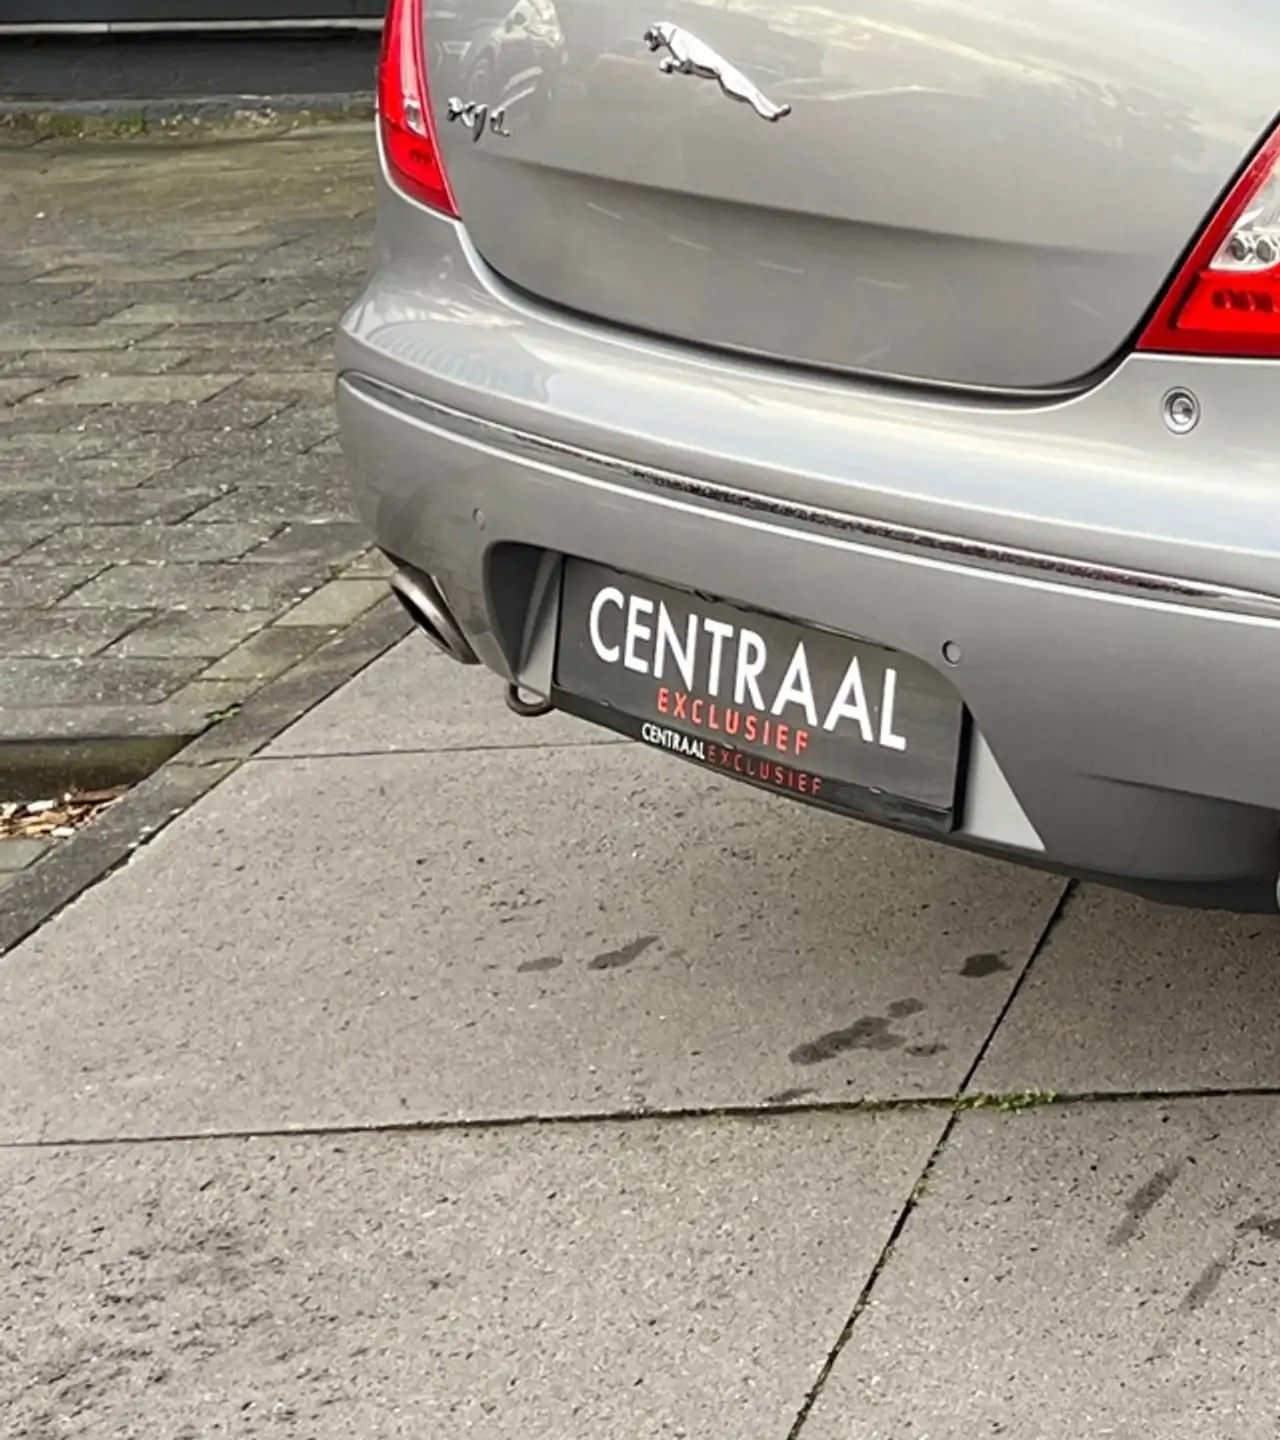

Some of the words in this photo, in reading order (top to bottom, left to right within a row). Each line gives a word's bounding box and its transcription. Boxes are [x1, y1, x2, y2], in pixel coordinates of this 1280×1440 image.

[589, 586, 907, 751] CENTRAAL
[641, 721, 706, 761] CENTRAAL
[707, 744, 823, 796] EXCLUSIEF
[656, 687, 810, 756] EXCLUSIEF
